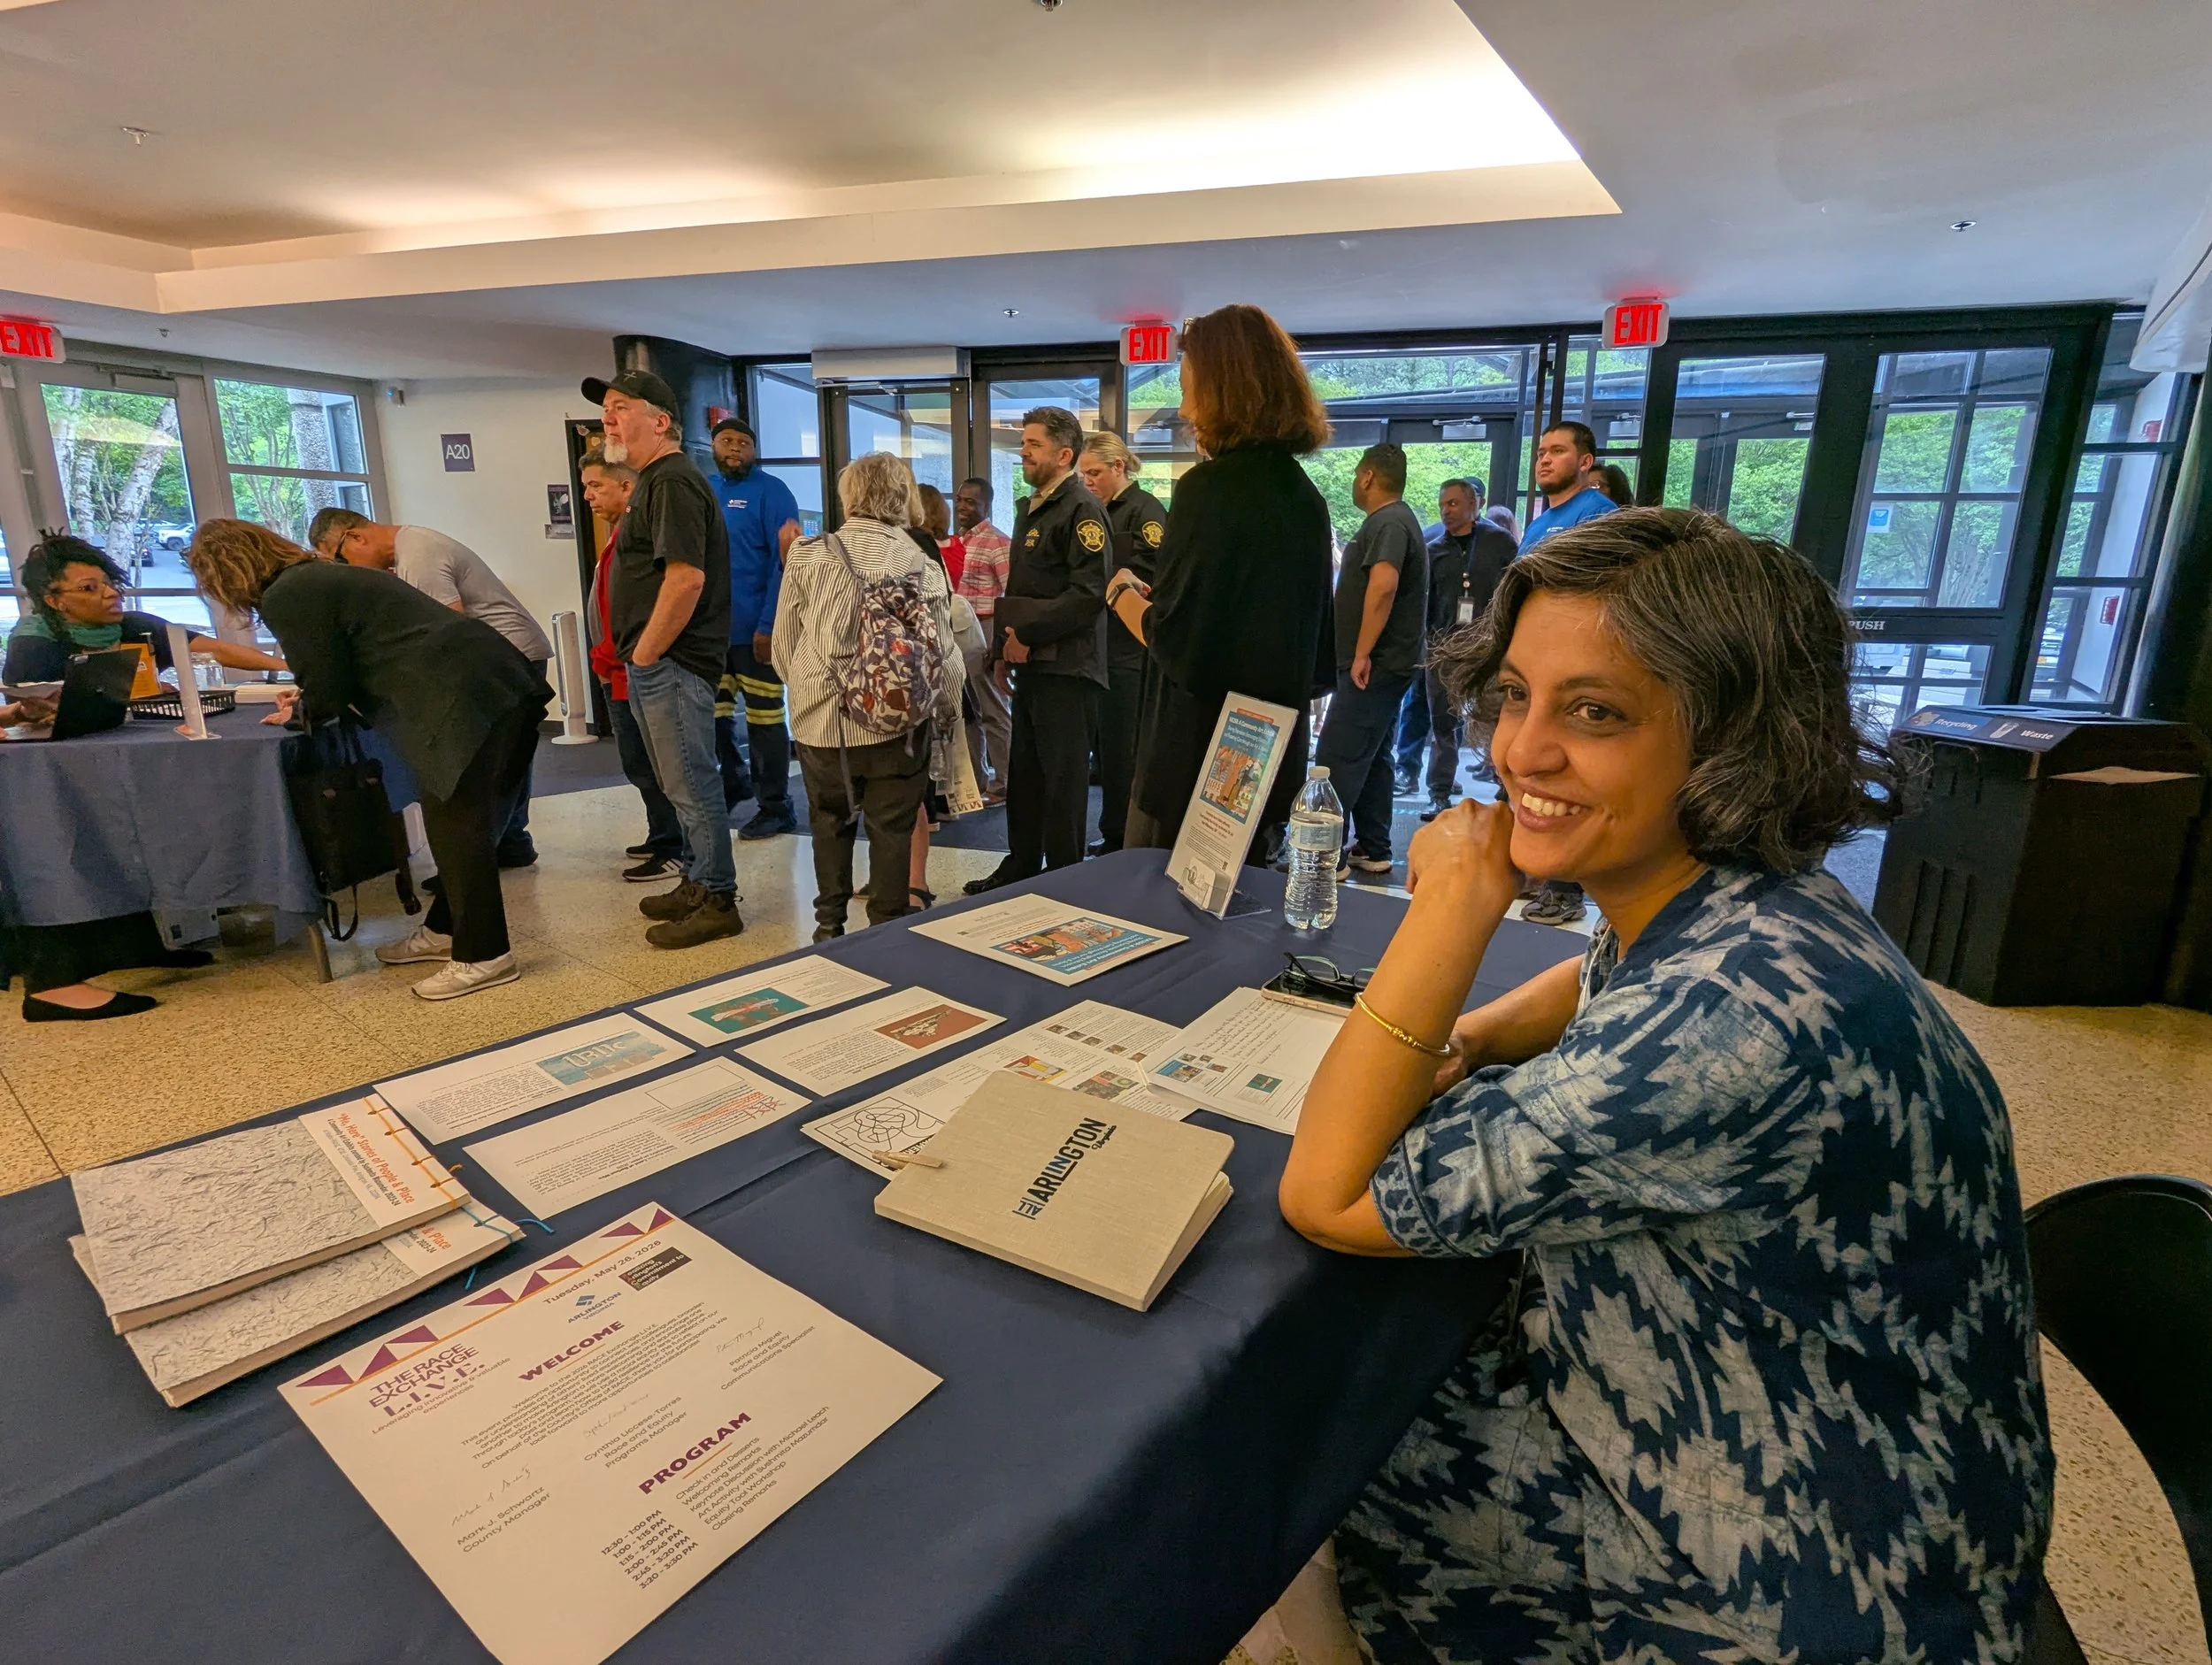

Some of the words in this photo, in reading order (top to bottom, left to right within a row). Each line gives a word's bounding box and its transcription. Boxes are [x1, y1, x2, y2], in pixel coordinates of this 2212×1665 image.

[0, 321, 53, 357] EXIT
[1129, 326, 1171, 362] EXIT
[1614, 304, 1663, 344] EXIT
[446, 444, 471, 460] A20
[1848, 620, 1886, 631] PUSH
[1934, 718, 1978, 731] Recycling
[2020, 729, 2055, 740] Waste
[326, 1120, 344, 1135] Community
[361, 1162, 378, 1177] Sushmita
[384, 1191, 402, 1206] 2023-24
[344, 1124, 365, 1140] Here"
[357, 1139, 380, 1157] Stories
[373, 1162, 400, 1184] People
[396, 1185, 418, 1203] Place
[1026, 1117, 1107, 1203] ARLINGTON
[1091, 1125, 1117, 1150] Virginia
[1019, 1200, 1043, 1216] ALL
[428, 1232, 451, 1249] Place
[541, 1276, 595, 1306] Tuesday,
[593, 1263, 619, 1278] May
[616, 1255, 635, 1265] 26,
[633, 1239, 663, 1255] 2026
[629, 1258, 677, 1285] Commitment
[565, 1291, 622, 1323] ARLINGTON
[582, 1301, 615, 1320] VIRGINIA
[369, 1369, 415, 1396] THE
[411, 1342, 466, 1374] RACE
[518, 1320, 625, 1384] WELCOME
[719, 1347, 782, 1391] Communications
[780, 1324, 817, 1350] Specialist
[728, 1346, 758, 1366] Patricia
[757, 1330, 783, 1348] Miguel
[732, 1358, 753, 1373] Race
[750, 1347, 769, 1360] and
[766, 1333, 791, 1350] Equity
[368, 1346, 480, 1408] EXCHANGE
[371, 1403, 424, 1435] Leveraging
[423, 1379, 468, 1406] innovative
[475, 1356, 511, 1377] valuable
[382, 1357, 485, 1417] L.I.V.E.
[422, 1383, 474, 1414] experiences
[472, 1437, 508, 1461] Through
[506, 1418, 538, 1439] today's
[614, 1359, 636, 1373] racial
[635, 1347, 658, 1362] equity
[677, 1321, 699, 1335] reflect
[480, 1458, 495, 1469] On
[494, 1441, 523, 1460] behalf
[532, 1426, 547, 1437] the
[545, 1407, 580, 1430] County's
[579, 1392, 603, 1408] Office
[630, 1362, 652, 1376] thank
[715, 1316, 728, 1324] We
[511, 1386, 549, 1409] Welcome
[557, 1373, 571, 1382] the
[570, 1363, 588, 1375] 2026
[587, 1352, 606, 1365] RACE
[582, 1435, 621, 1462] Cynthia
[619, 1395, 681, 1437] Liccese-Torres
[603, 1440, 628, 1458] Race
[627, 1428, 648, 1442] and
[646, 1409, 675, 1430] Equity
[604, 1437, 650, 1469] Programs
[648, 1410, 688, 1439] Manager
[637, 1411, 752, 1495] PROGRAM
[674, 1478, 703, 1500] Check
[709, 1460, 727, 1474] and
[726, 1436, 760, 1462] Desserts
[681, 1470, 730, 1507] Welcoming
[726, 1446, 762, 1472] Remarks
[688, 1485, 726, 1513] Keynote
[722, 1454, 764, 1487] Discussion
[762, 1442, 780, 1457] with
[778, 1421, 809, 1445] Michael
[805, 1405, 830, 1423] Leach
[696, 1506, 712, 1519] Art
[709, 1484, 741, 1509] Activity
[738, 1471, 757, 1486] with
[755, 1445, 792, 1473] Sushmita
[788, 1416, 830, 1447] Mazumdar
[456, 1524, 486, 1546] Mark
[495, 1485, 545, 1519] Schwartz
[703, 1503, 732, 1525] Equity
[728, 1490, 749, 1506] Tool
[746, 1460, 787, 1492] Workshop
[710, 1505, 745, 1532] Closing
[741, 1478, 778, 1508] Remarks
[461, 1524, 503, 1554] County
[503, 1492, 553, 1527] Manager
[601, 1537, 624, 1555] 12:30
[627, 1520, 647, 1535] 1:00
[645, 1508, 662, 1523] PM
[612, 1543, 632, 1559] 1:00
[635, 1528, 651, 1541] 1:15
[649, 1516, 666, 1531] PM
[618, 1553, 635, 1567] 1:15
[638, 1534, 659, 1551] 2:00
[657, 1523, 674, 1537] PM
[623, 1557, 646, 1575] 2:00
[649, 1539, 668, 1555] 2:45
[666, 1528, 683, 1542] PM
[632, 1565, 651, 1582] 2:45
[655, 1546, 676, 1563] 3:20
[673, 1534, 691, 1549] PM
[638, 1571, 660, 1589] 3:20
[663, 1553, 683, 1569] 3:30
[681, 1540, 699, 1555] PM
